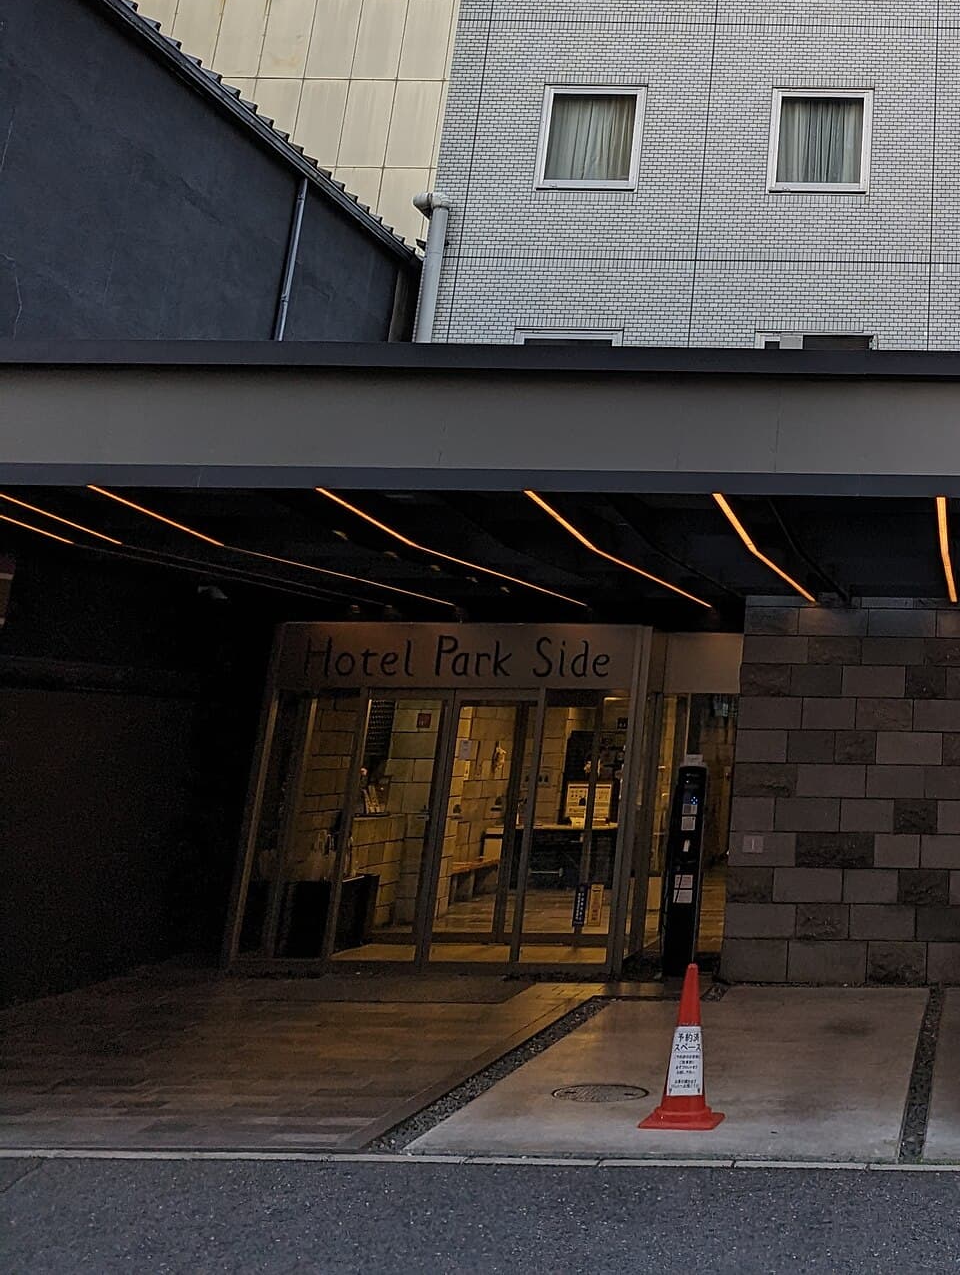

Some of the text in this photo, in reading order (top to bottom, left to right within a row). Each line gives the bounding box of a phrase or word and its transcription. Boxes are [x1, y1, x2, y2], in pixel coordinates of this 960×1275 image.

[303, 635, 611, 678] Hotel Park Side
[674, 1043, 702, 1052] スペース
